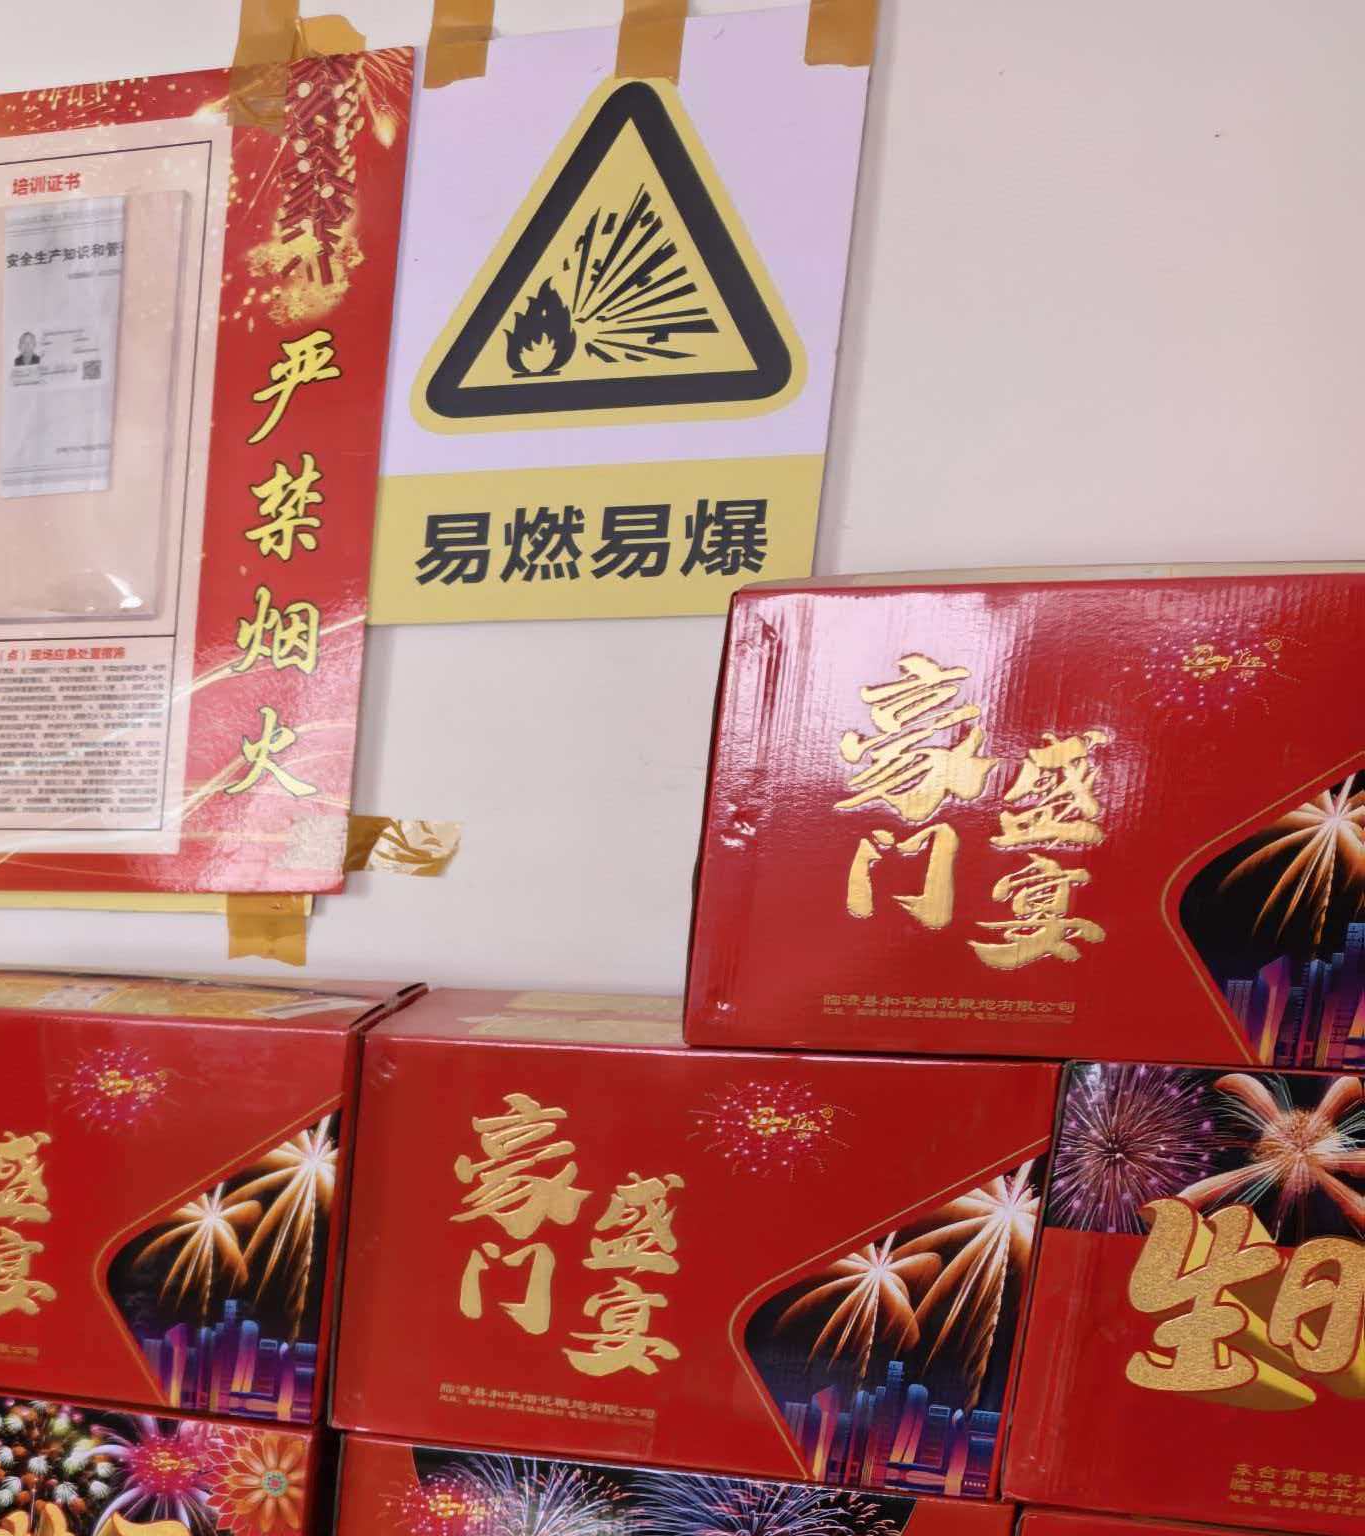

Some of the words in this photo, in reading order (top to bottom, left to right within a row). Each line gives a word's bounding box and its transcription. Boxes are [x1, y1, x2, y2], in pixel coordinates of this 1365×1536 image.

[12, 172, 81, 196] 培训证书
[224, 330, 342, 800] 严禁烟火
[415, 498, 770, 587] 易燃易爆
[834, 652, 997, 931] 豪门
[967, 729, 1109, 971] 盛宴
[450, 1093, 593, 1335] 豪门
[562, 1171, 685, 1377] 盛宴
